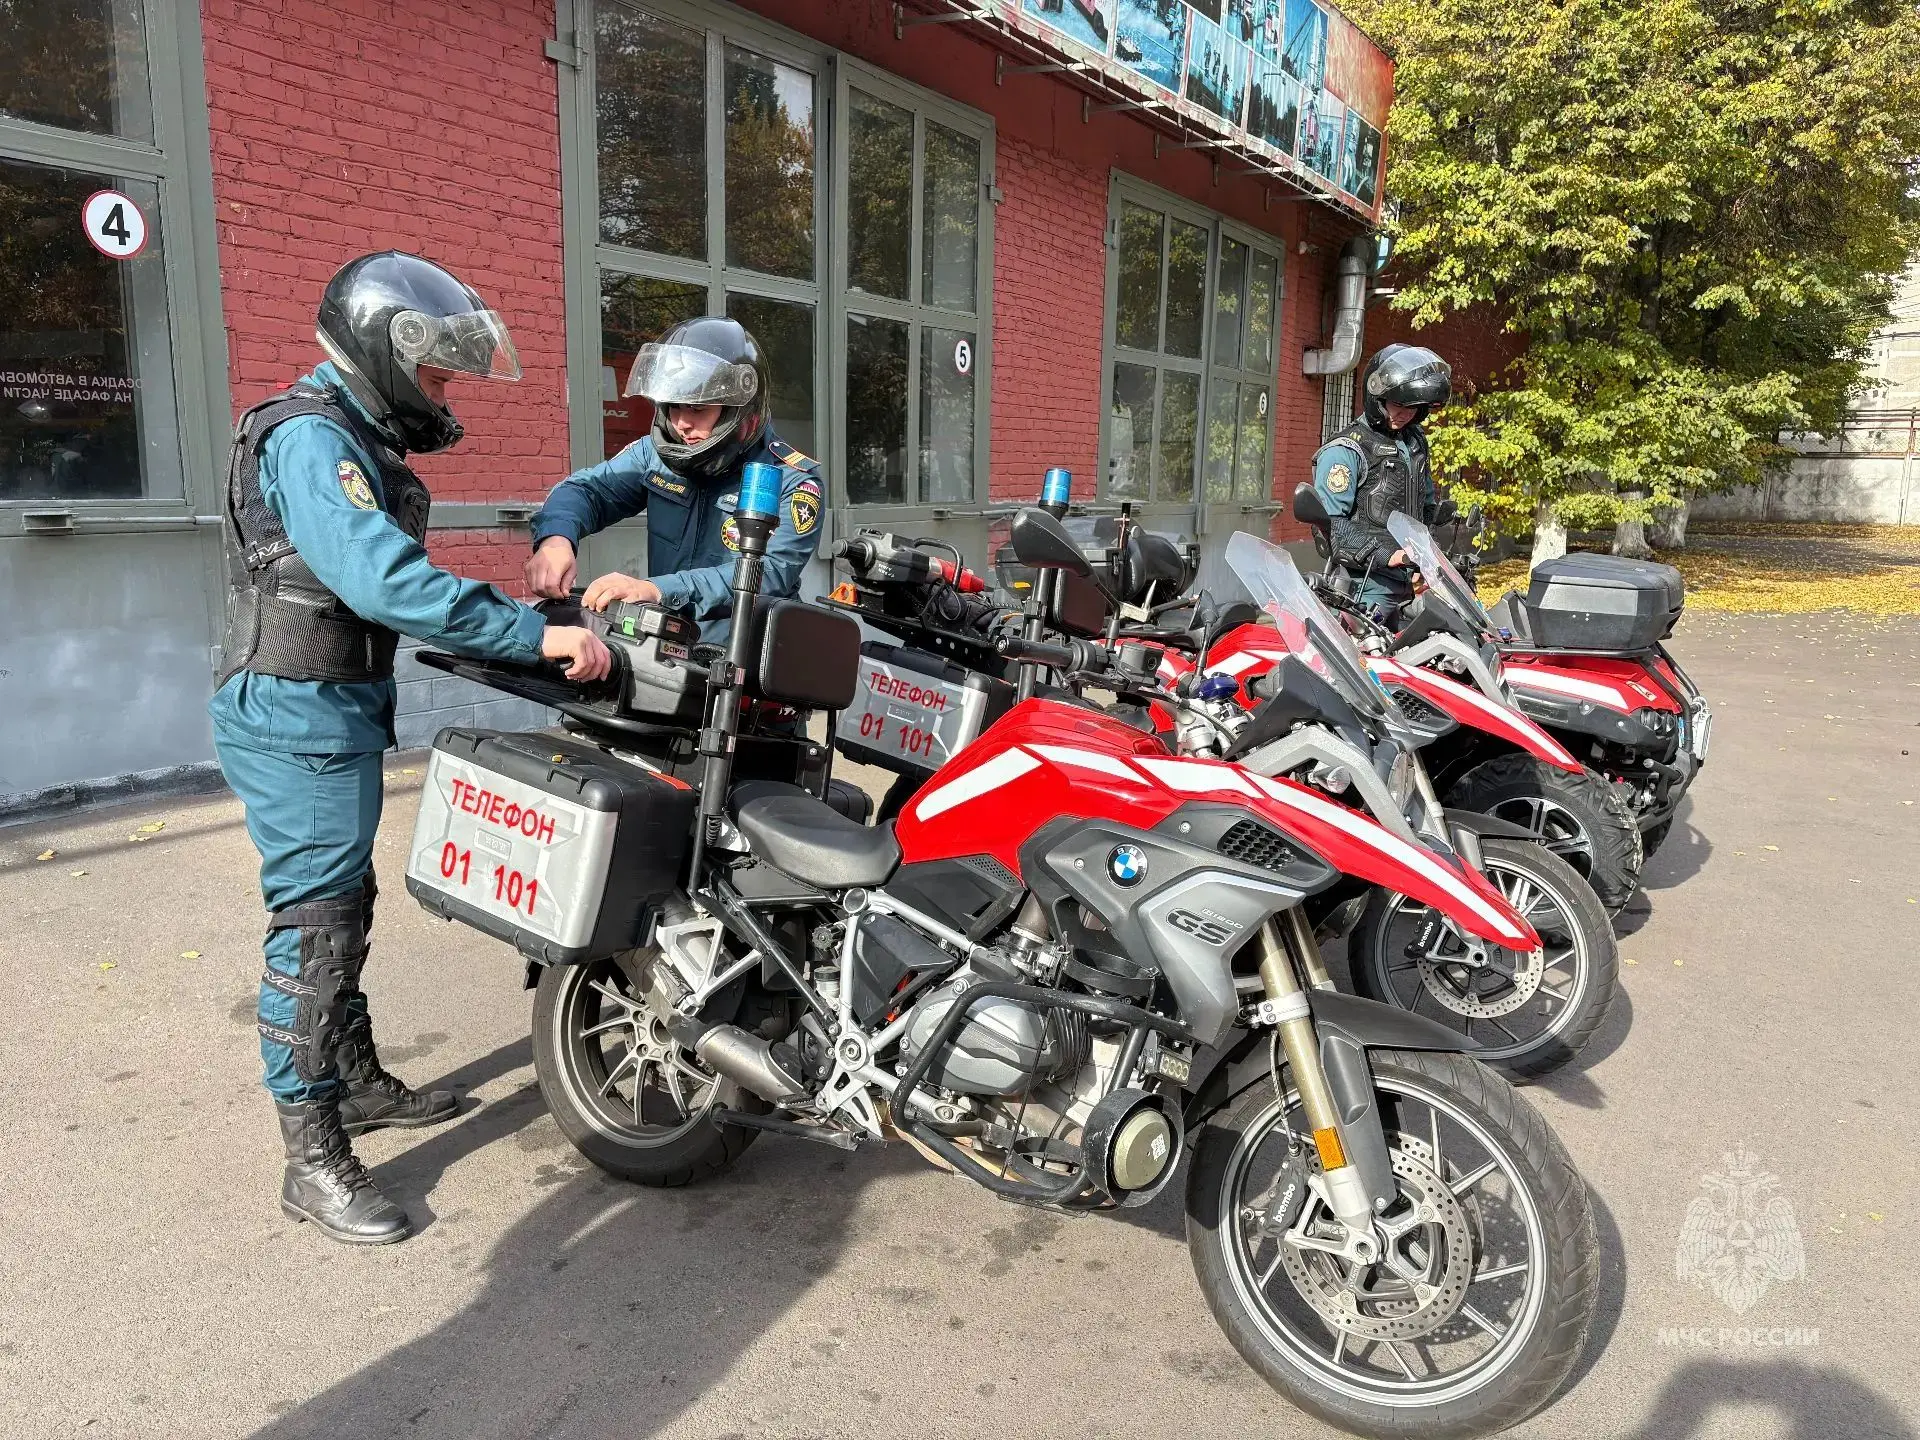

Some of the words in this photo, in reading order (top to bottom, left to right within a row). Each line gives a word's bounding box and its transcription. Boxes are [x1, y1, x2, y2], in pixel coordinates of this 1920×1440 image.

[101, 203, 131, 246] 4
[959, 345, 967, 369] 5
[869, 671, 947, 711] ТЕЛЕФОН
[860, 712, 884, 740] 01
[899, 725, 934, 757] 101
[452, 778, 556, 845] ТЕЛЕФОН
[440, 841, 472, 886] 01
[494, 864, 539, 916] 101
[1166, 907, 1236, 947] GS
[1417, 921, 1434, 948] brembo
[1272, 1183, 1296, 1224] brembo
